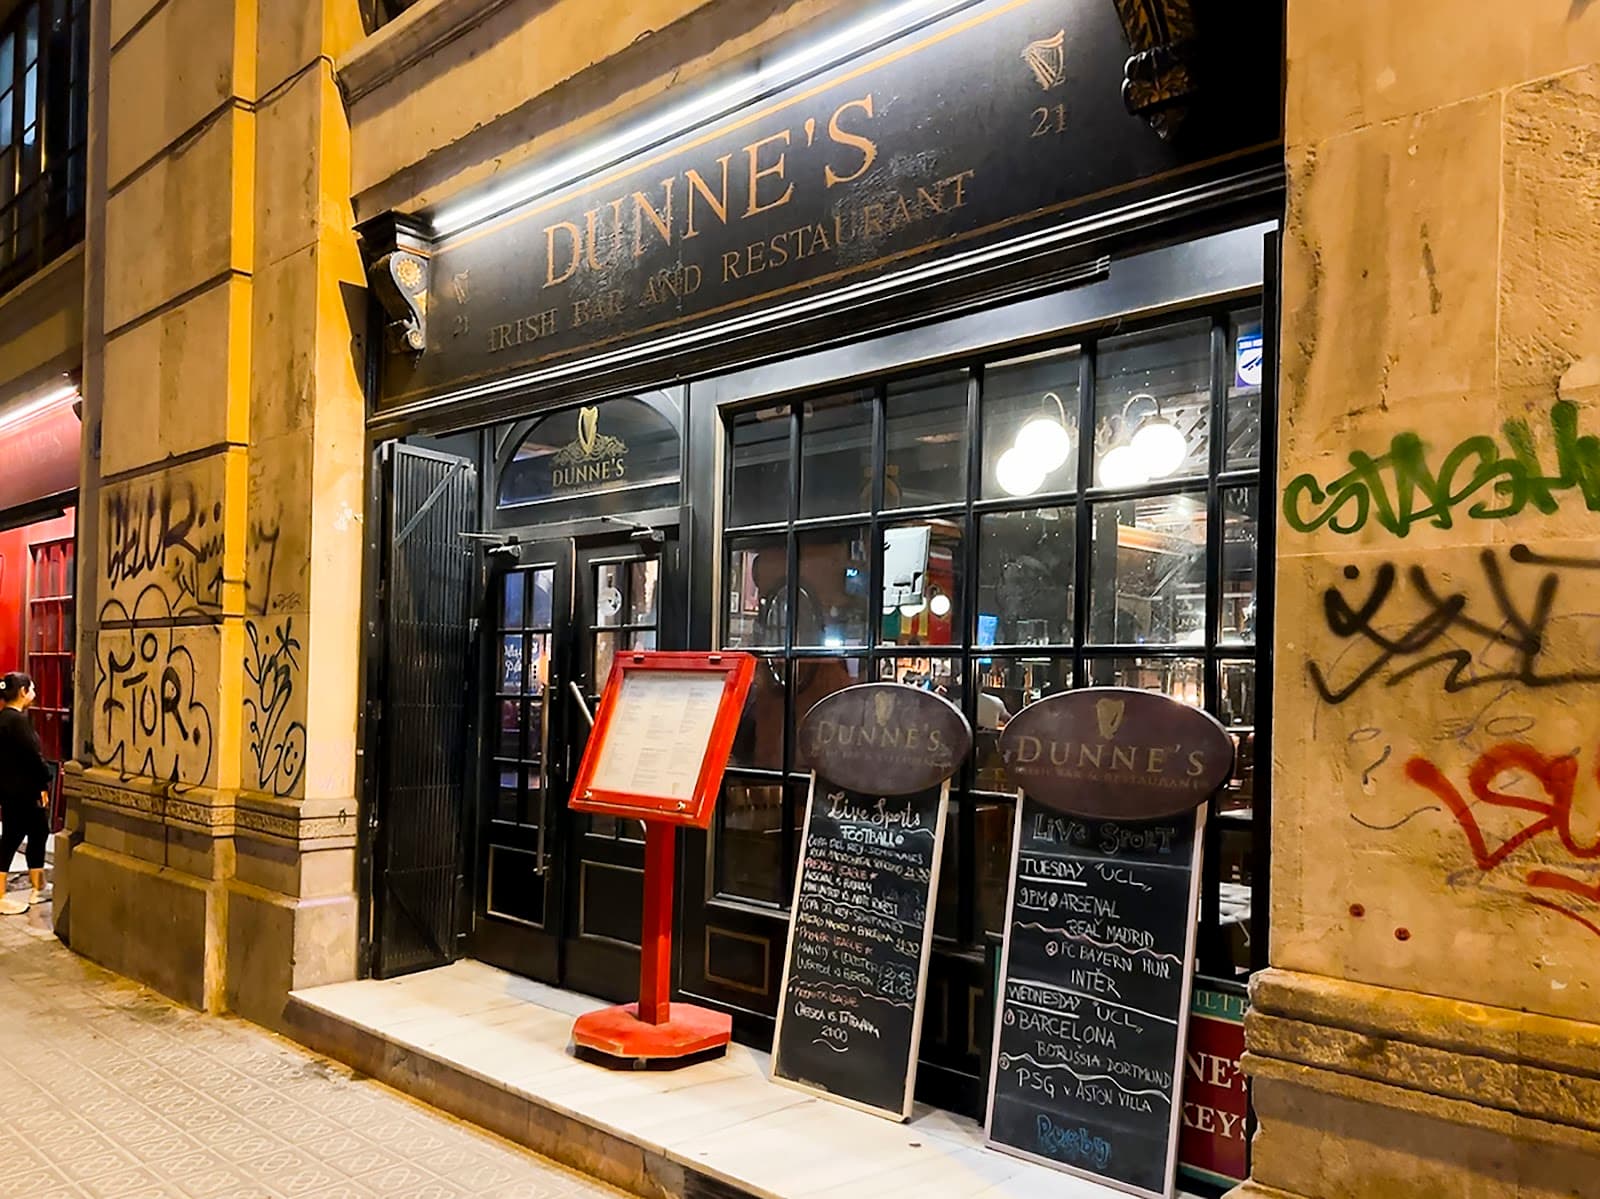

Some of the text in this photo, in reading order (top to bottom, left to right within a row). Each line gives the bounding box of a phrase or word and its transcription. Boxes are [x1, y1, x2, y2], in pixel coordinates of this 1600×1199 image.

[1030, 103, 1067, 138] 21
[543, 94, 878, 289] DUNNE'S
[488, 169, 975, 352] IRISH BAR AND RESTAURANT
[552, 458, 625, 488] DUNNE'S
[817, 720, 942, 752] DUNNE'S
[1016, 735, 1205, 776] DUNNE'S
[827, 791, 920, 829] Live Sports
[840, 825, 896, 848] FOOTBALL
[1019, 857, 1085, 879] TUESDAY
[1059, 892, 1120, 918] ARSENAL
[1066, 919, 1154, 948] REAL MADRID
[1061, 942, 1076, 958] FC
[1080, 945, 1132, 972] BAYERN
[1007, 985, 1080, 1011] WEDNESDAY
[1070, 968, 1121, 998] INTER
[1017, 1009, 1117, 1049] BARCELONA
[1035, 1040, 1172, 1089] BORUSSIA DORTMUND
[1016, 1067, 1055, 1099] PSG
[1075, 1080, 1113, 1105] ASTON
[1118, 1093, 1152, 1113] VILLA
